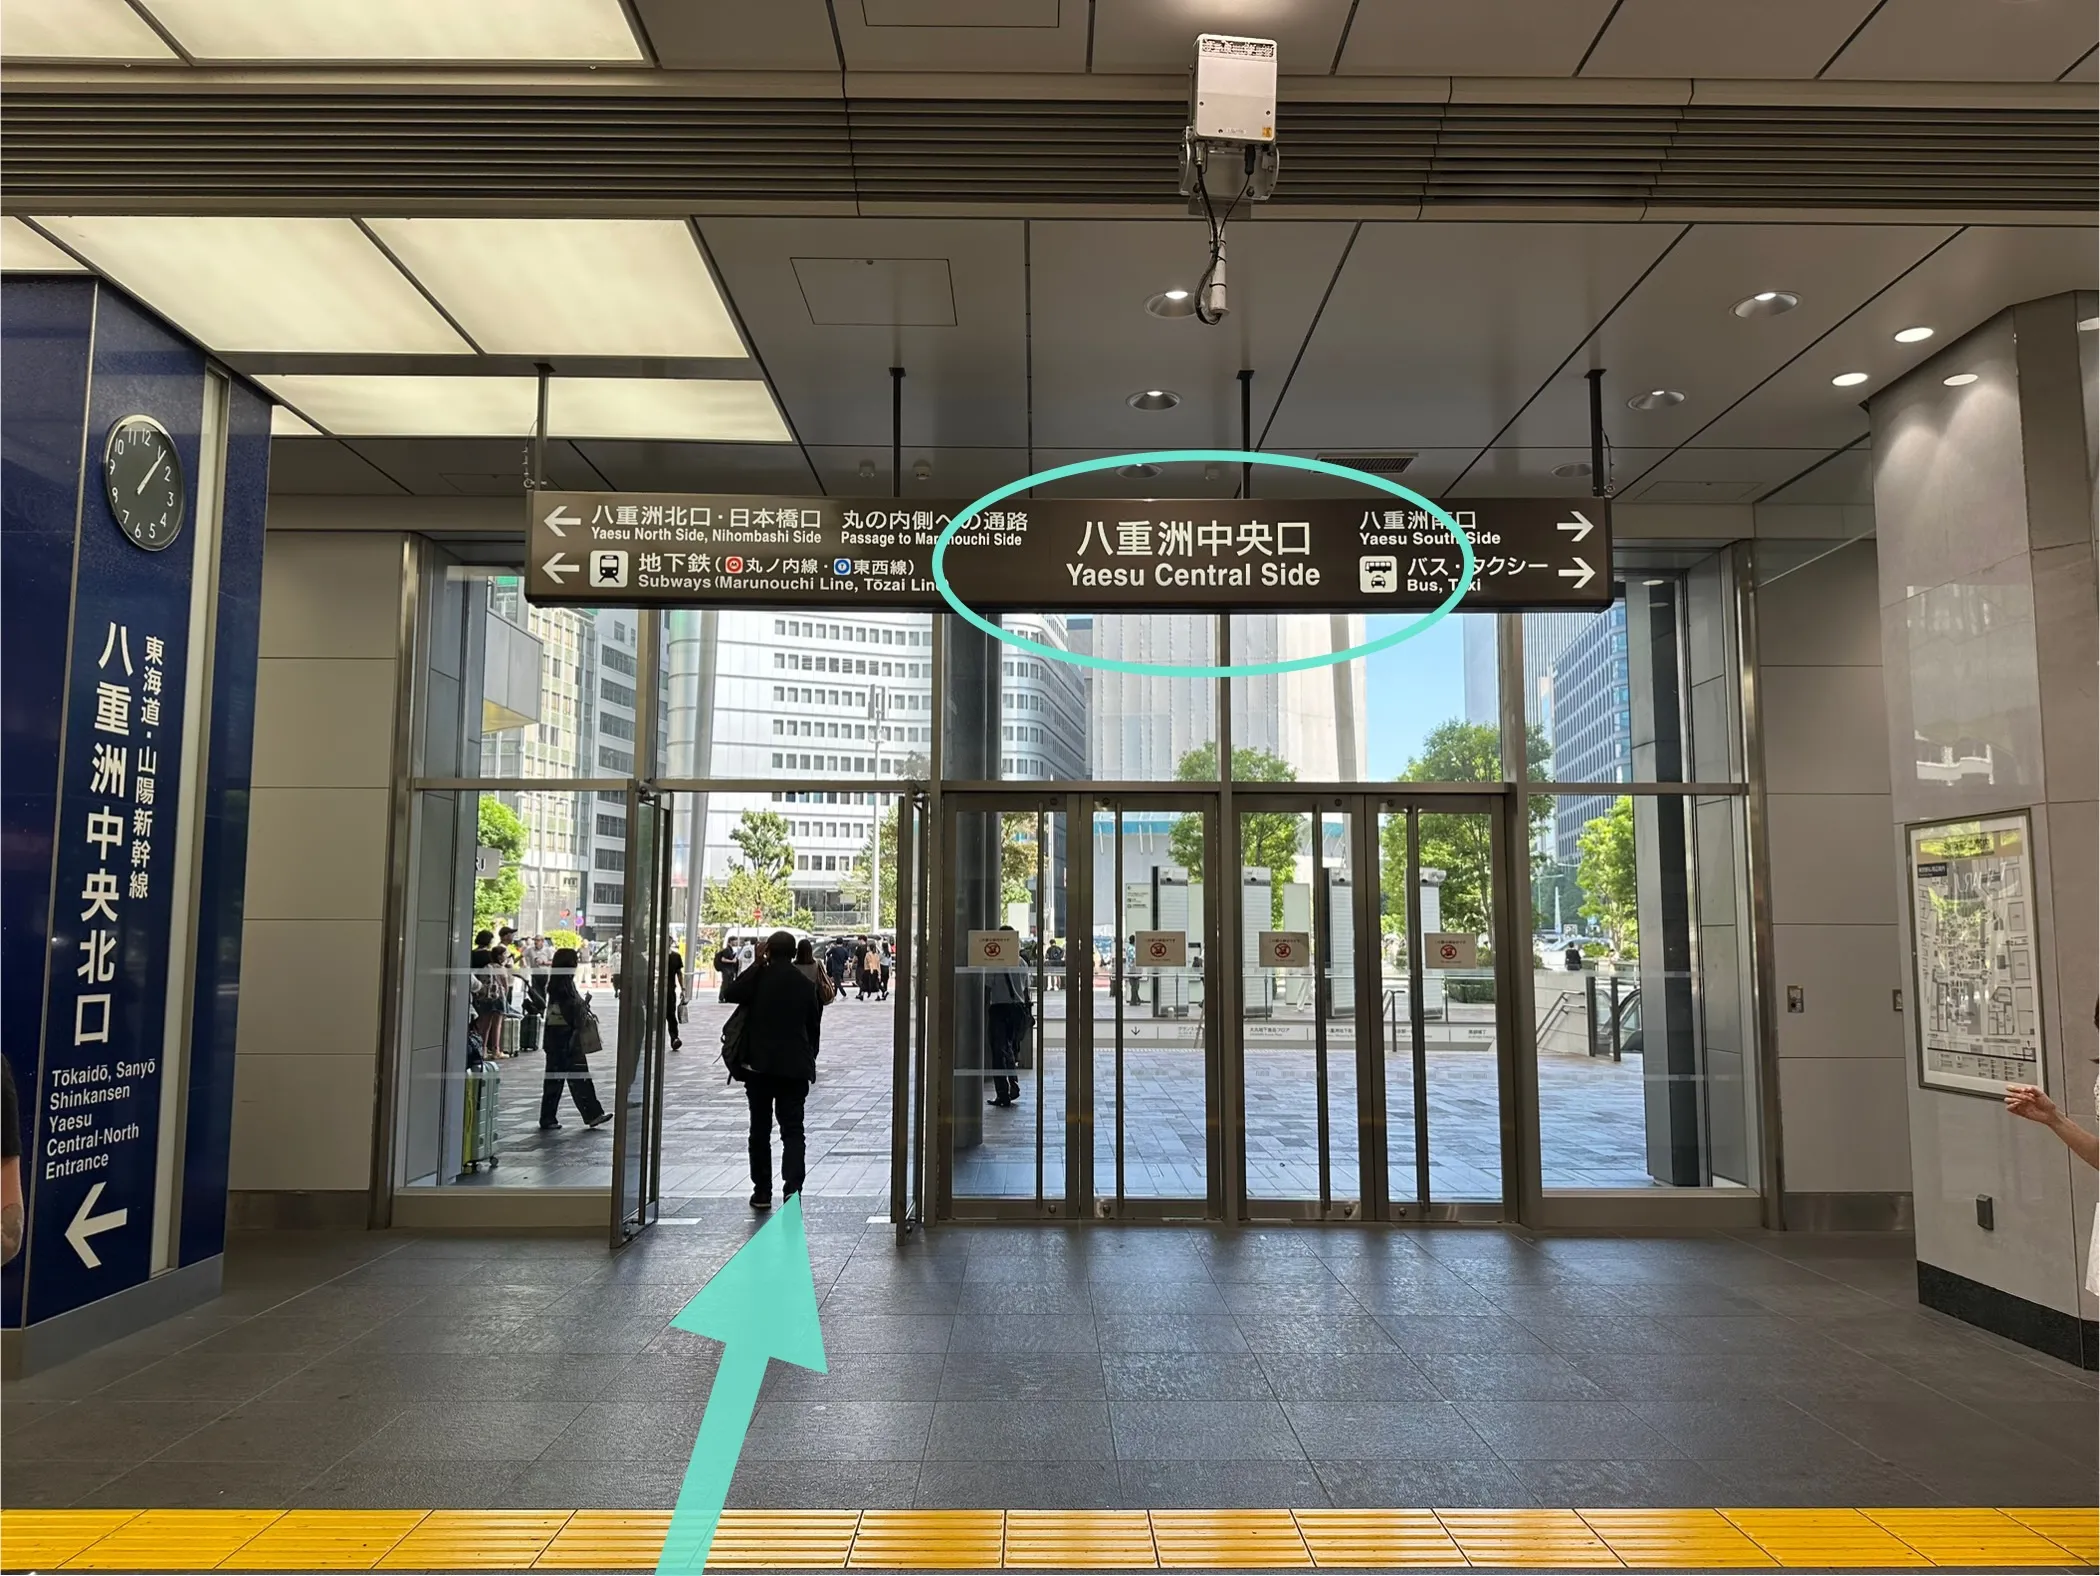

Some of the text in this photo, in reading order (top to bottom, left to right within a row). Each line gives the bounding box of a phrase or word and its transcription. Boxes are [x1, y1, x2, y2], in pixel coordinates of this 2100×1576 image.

[128, 427, 136, 446] 11
[141, 427, 151, 447] 12
[115, 438, 124, 455] 10
[110, 459, 116, 475] 9
[164, 465, 172, 482] 2
[112, 487, 118, 503] 8
[166, 491, 174, 507] 3
[122, 509, 130, 524] 7
[160, 512, 167, 527] 4
[591, 505, 821, 529] 八重洲北口・日本橋口
[134, 522, 141, 539] 6
[148, 523, 156, 539] 5
[591, 525, 822, 544] Yaesu North Side, Nihombashi Side
[841, 531, 1022, 547] Passage to Marnouchi Side
[1076, 520, 1311, 557] 八重洲中央口
[1359, 531, 1501, 546] Yaesu South Side
[638, 574, 712, 591] Subways
[715, 575, 815, 590] (Marunouchi
[820, 577, 859, 593] Line,
[1066, 562, 1321, 587] Yaesu Central Side
[1407, 578, 1481, 593] Bus, Txi
[128, 635, 165, 899] 東海道・山陽新幹線
[74, 621, 134, 1046] 八重洲中央北口
[52, 1058, 156, 1088] Tōkaidō, Sanyō
[50, 1085, 131, 1111] Shinkansen
[49, 1113, 93, 1134] Yaesu
[46, 1122, 140, 1158] Central-North
[45, 1153, 109, 1181] Entrance
